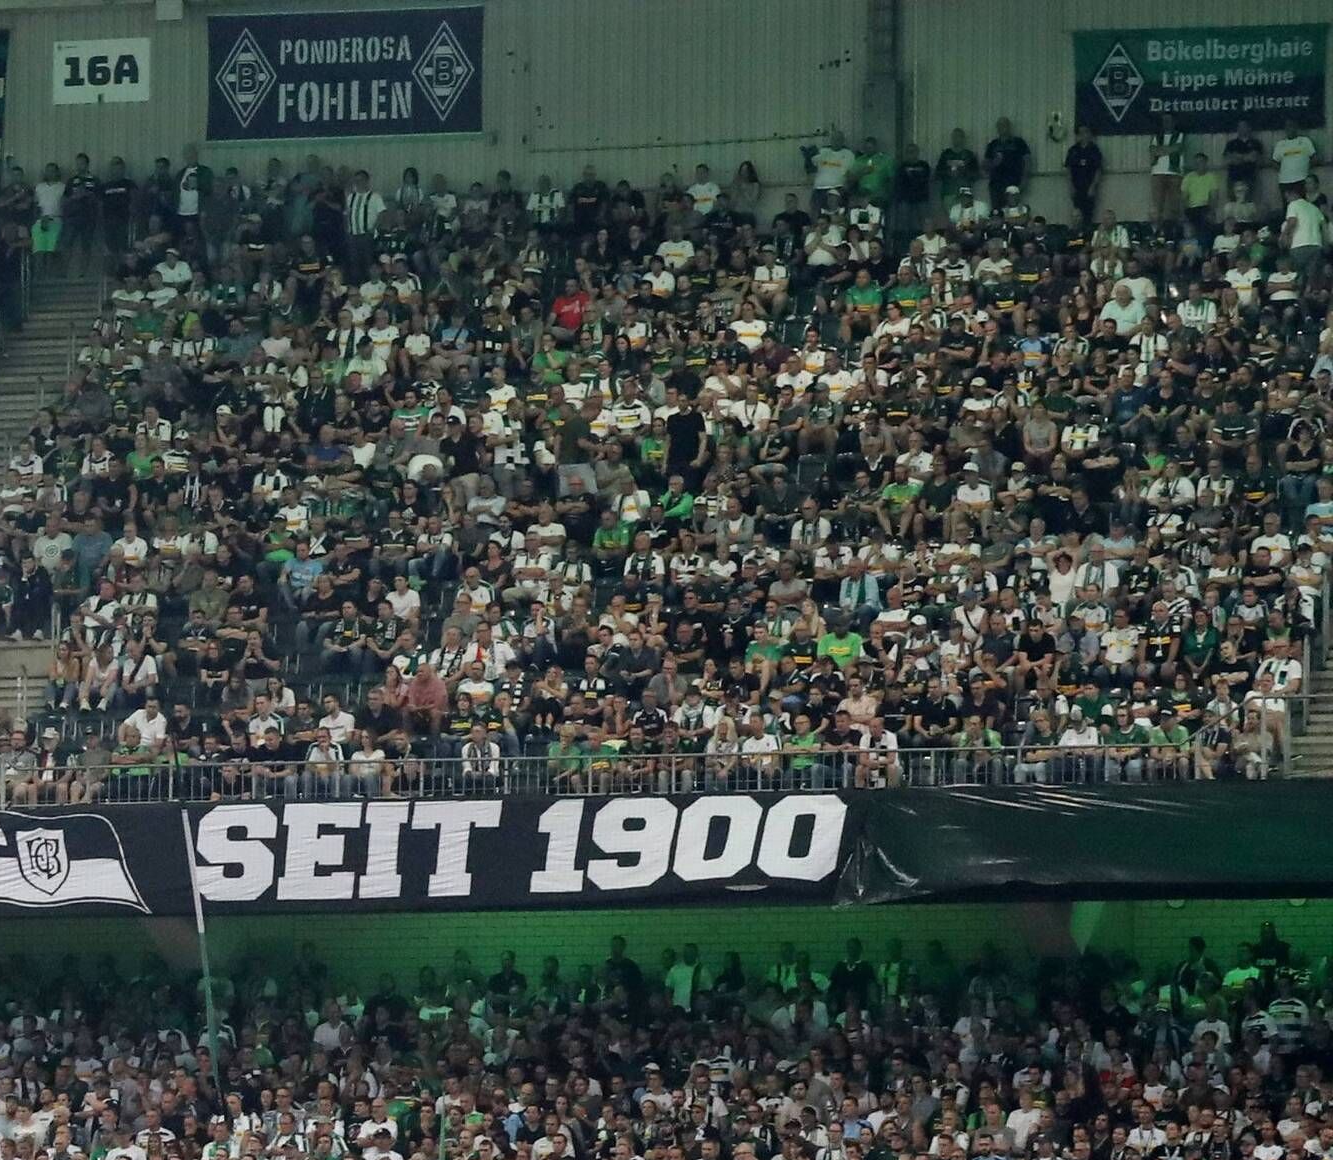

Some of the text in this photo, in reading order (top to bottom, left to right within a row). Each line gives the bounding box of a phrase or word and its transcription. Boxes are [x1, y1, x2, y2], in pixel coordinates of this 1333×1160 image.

[279, 35, 412, 66] PONDEROSA
[1147, 36, 1313, 63] Bökelberghaie
[64, 54, 139, 87] 16A
[1162, 68, 1295, 91] Lippe Möhne
[278, 78, 412, 123] FOHLEN
[195, 794, 848, 902] SEIT 1900
